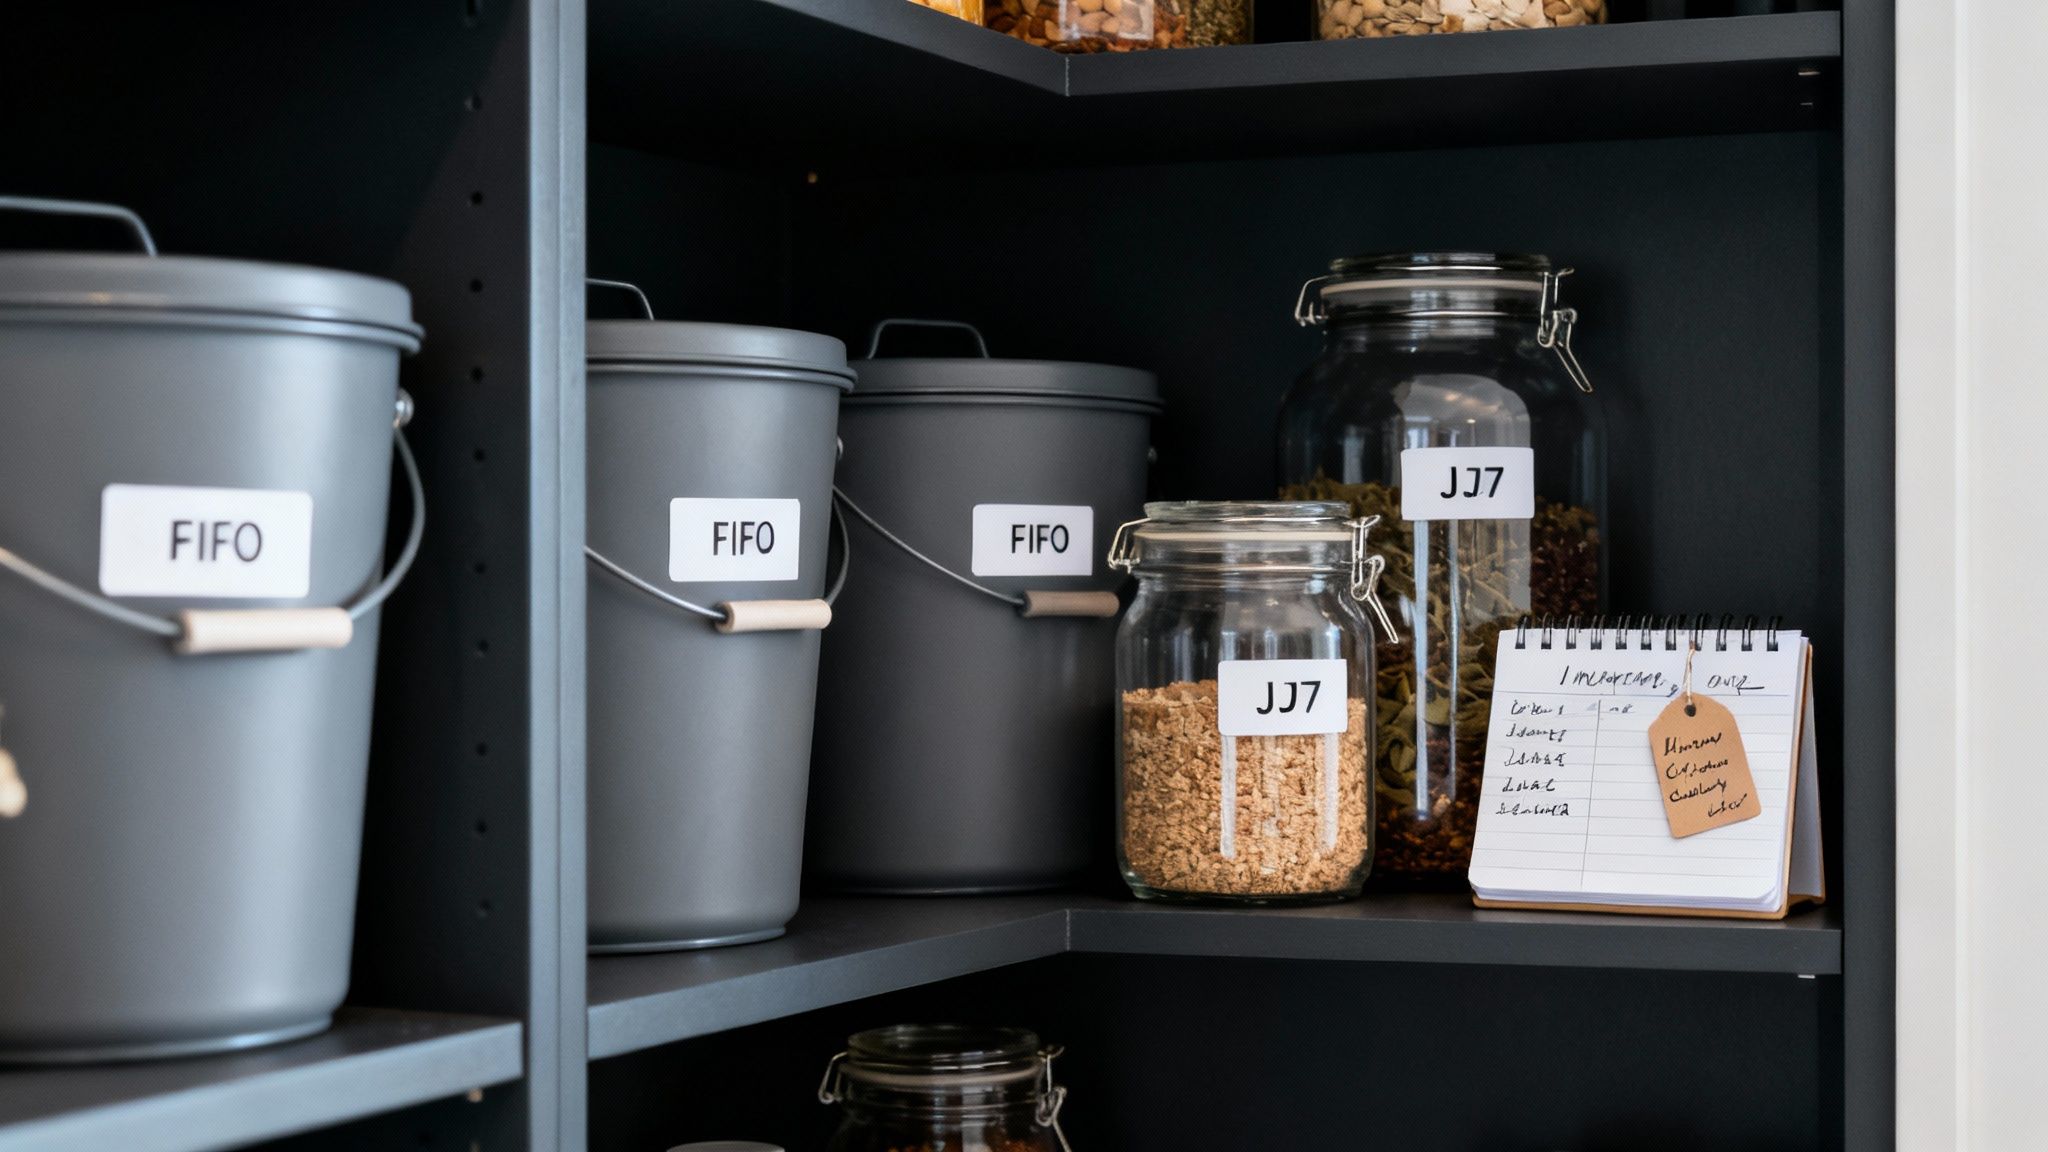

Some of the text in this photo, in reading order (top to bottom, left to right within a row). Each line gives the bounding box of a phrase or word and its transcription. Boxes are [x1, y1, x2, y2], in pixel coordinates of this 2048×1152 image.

[1440, 466, 1505, 499] JJ7
[171, 520, 263, 563] FIFO
[713, 520, 775, 556] FIFO
[1011, 524, 1070, 554] FIFO
[1256, 680, 1321, 715] JJ7
